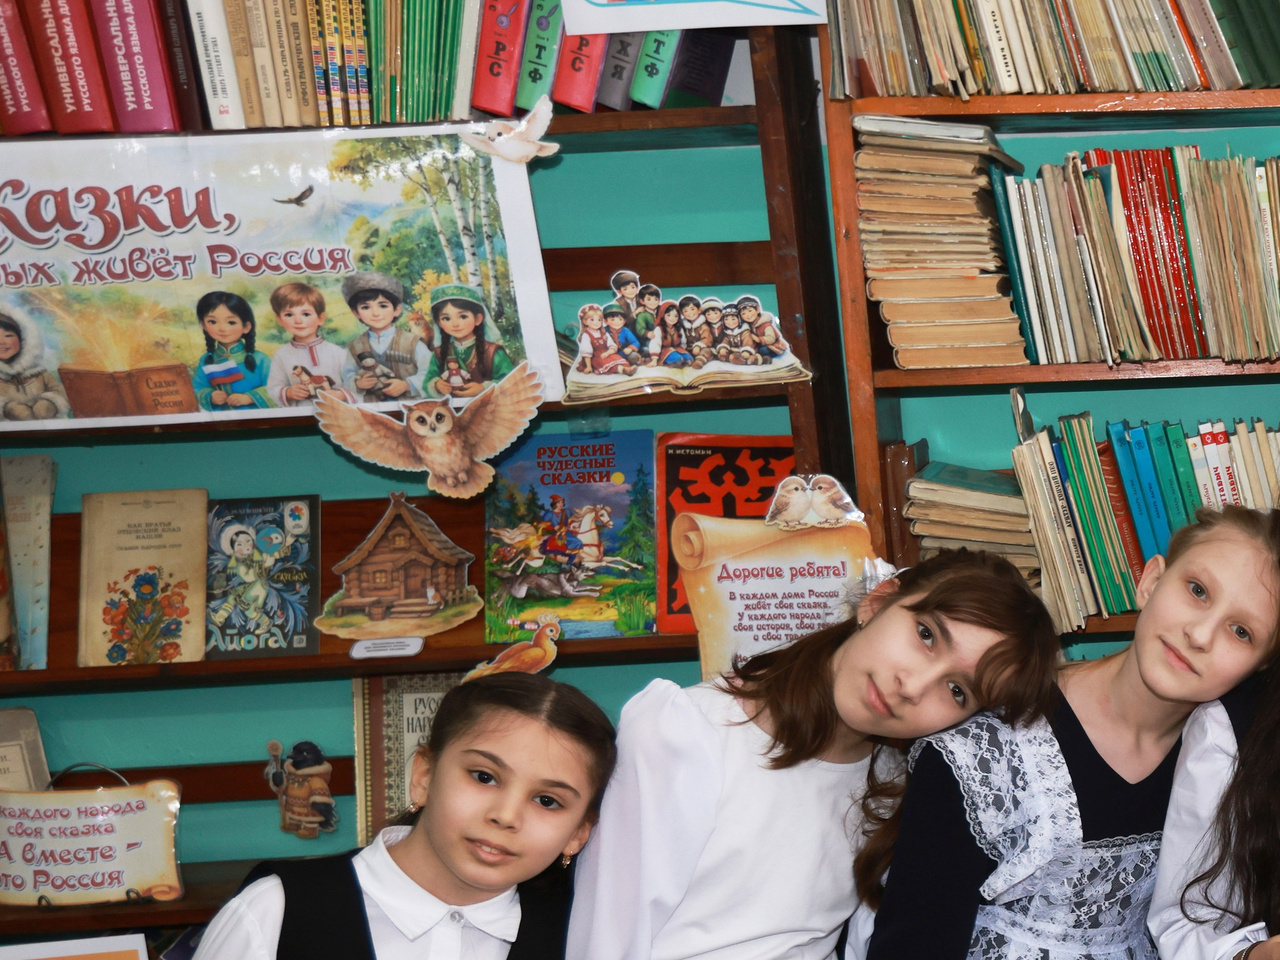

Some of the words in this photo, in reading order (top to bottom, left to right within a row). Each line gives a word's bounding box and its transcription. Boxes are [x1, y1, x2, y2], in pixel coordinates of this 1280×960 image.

[64, 15, 79, 55] ЯЗЫКА
[128, 14, 143, 54] ЯЗЫКА
[535, 44, 547, 60] Т
[653, 37, 666, 55] Т
[312, 44, 326, 96] СПРАВОЧНИК
[327, 41, 341, 93] СПРАВОЧНИК
[345, 43, 358, 95] СПРАВОЧНИК
[357, 43, 369, 94] СПРАВОЧНИК
[528, 68, 543, 84] Ф
[644, 63, 660, 79] Ф
[6, 55, 31, 112] РУССКОГО
[71, 55, 94, 112] РУССКОГО
[135, 54, 154, 111] РУССКОГО
[72, 247, 197, 285] живёт
[206, 243, 352, 277] Россия
[536, 443, 616, 460] РУССКИЕ
[536, 457, 616, 472] ЧУДЕСНЫЕ
[539, 470, 612, 486] СКАЗКИ
[717, 563, 785, 585] Дорогие
[789, 560, 848, 583] ребята!
[729, 591, 737, 601] В
[740, 591, 778, 601] каждом
[781, 591, 806, 600] доме
[808, 589, 840, 599] России
[744, 600, 772, 611] живёт
[774, 601, 795, 610] своя
[797, 600, 832, 610] сказка.
[737, 612, 745, 622] У
[747, 612, 787, 622] каждого
[789, 612, 822, 622] народа
[733, 623, 754, 632] своя
[756, 622, 793, 633] история,
[795, 621, 815, 631] свои
[753, 633, 759, 641] и
[761, 632, 783, 641] свои
[77, 799, 147, 818] народа
[7, 821, 44, 838] своя
[48, 822, 116, 838] сказка
[21, 841, 118, 865] вместе
[33, 868, 125, 891] Россия
